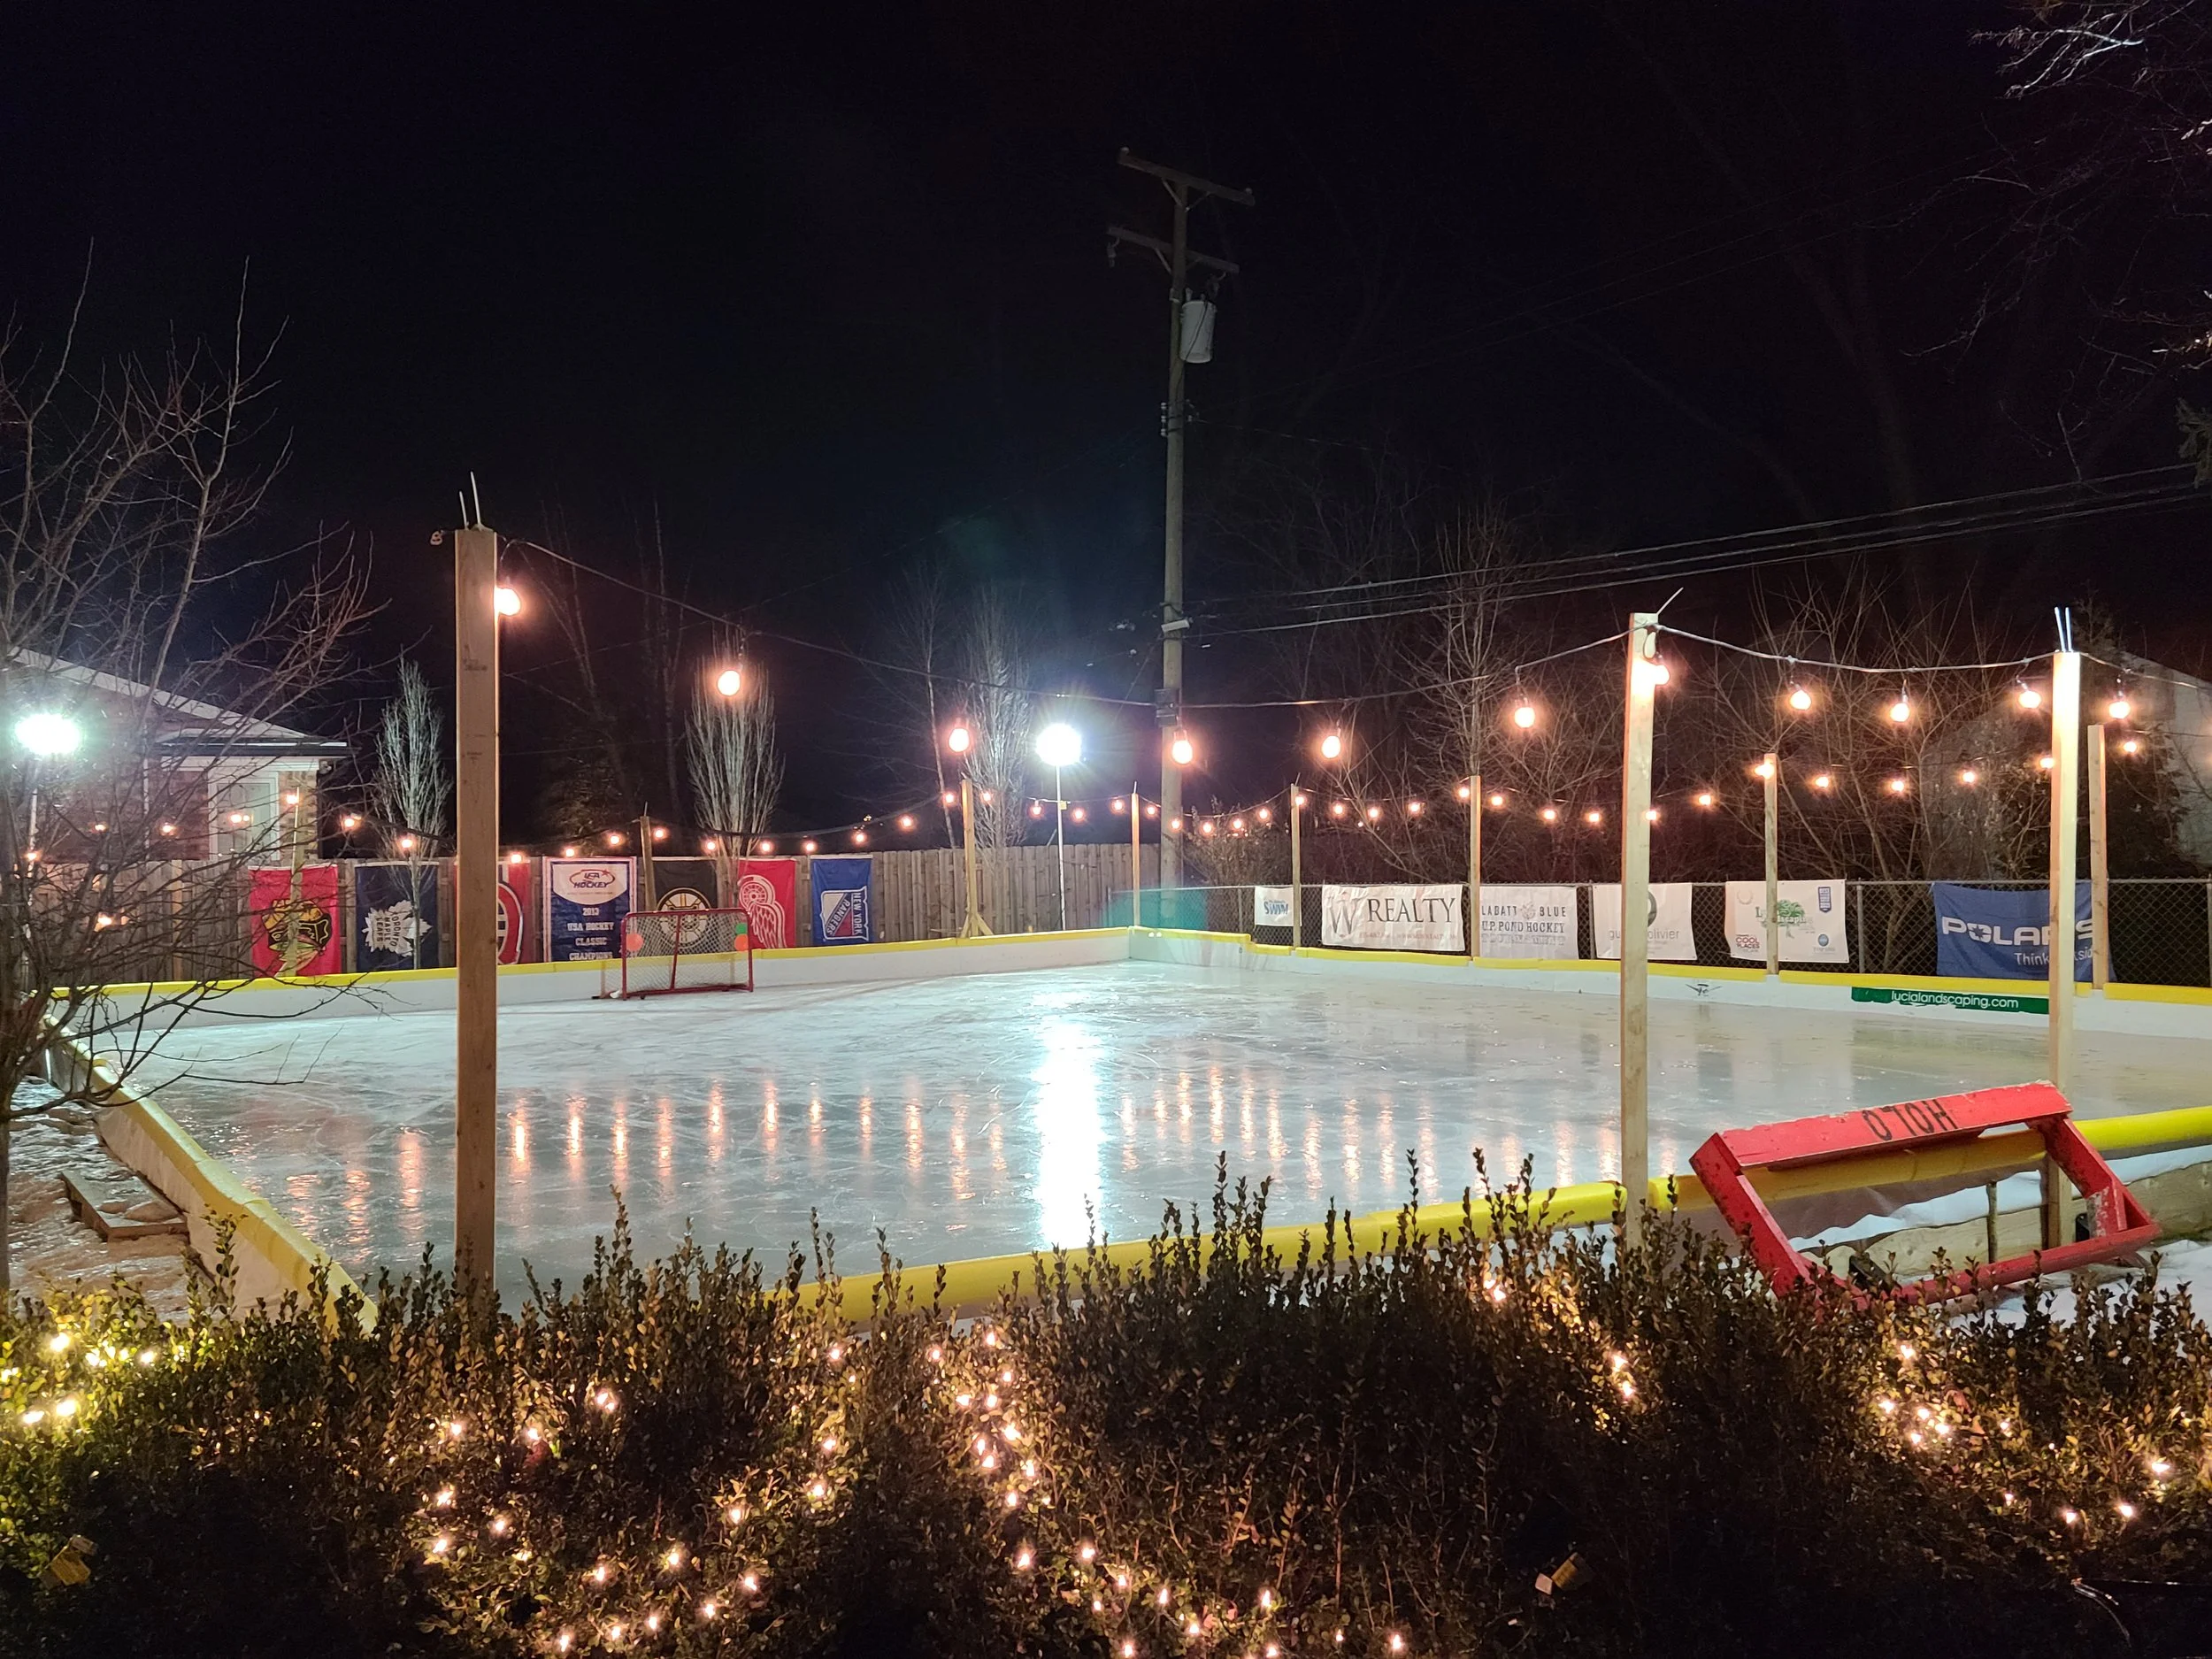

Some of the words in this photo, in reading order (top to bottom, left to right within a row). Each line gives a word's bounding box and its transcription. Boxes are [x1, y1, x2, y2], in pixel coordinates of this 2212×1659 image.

[853, 893, 862, 910] NEW
[826, 899, 850, 935] RANGERS
[1367, 897, 1456, 923] REALTY
[1481, 905, 1517, 916] LABATT
[1540, 906, 1566, 917] BLUE
[389, 911, 402, 947] TORONTO
[586, 922, 614, 931] HOCKEY
[854, 913, 863, 935] YORK
[1499, 921, 1524, 932] POND
[1526, 921, 1565, 933] HOCKEY
[1942, 917, 2093, 946] POLAS
[575, 937, 608, 946] CLASSIC
[1647, 929, 1679, 940] olivier
[569, 951, 613, 961] CHAMPIONS
[2014, 952, 2050, 966] Think
[1892, 990, 2018, 1008] lucialandscaping.com
